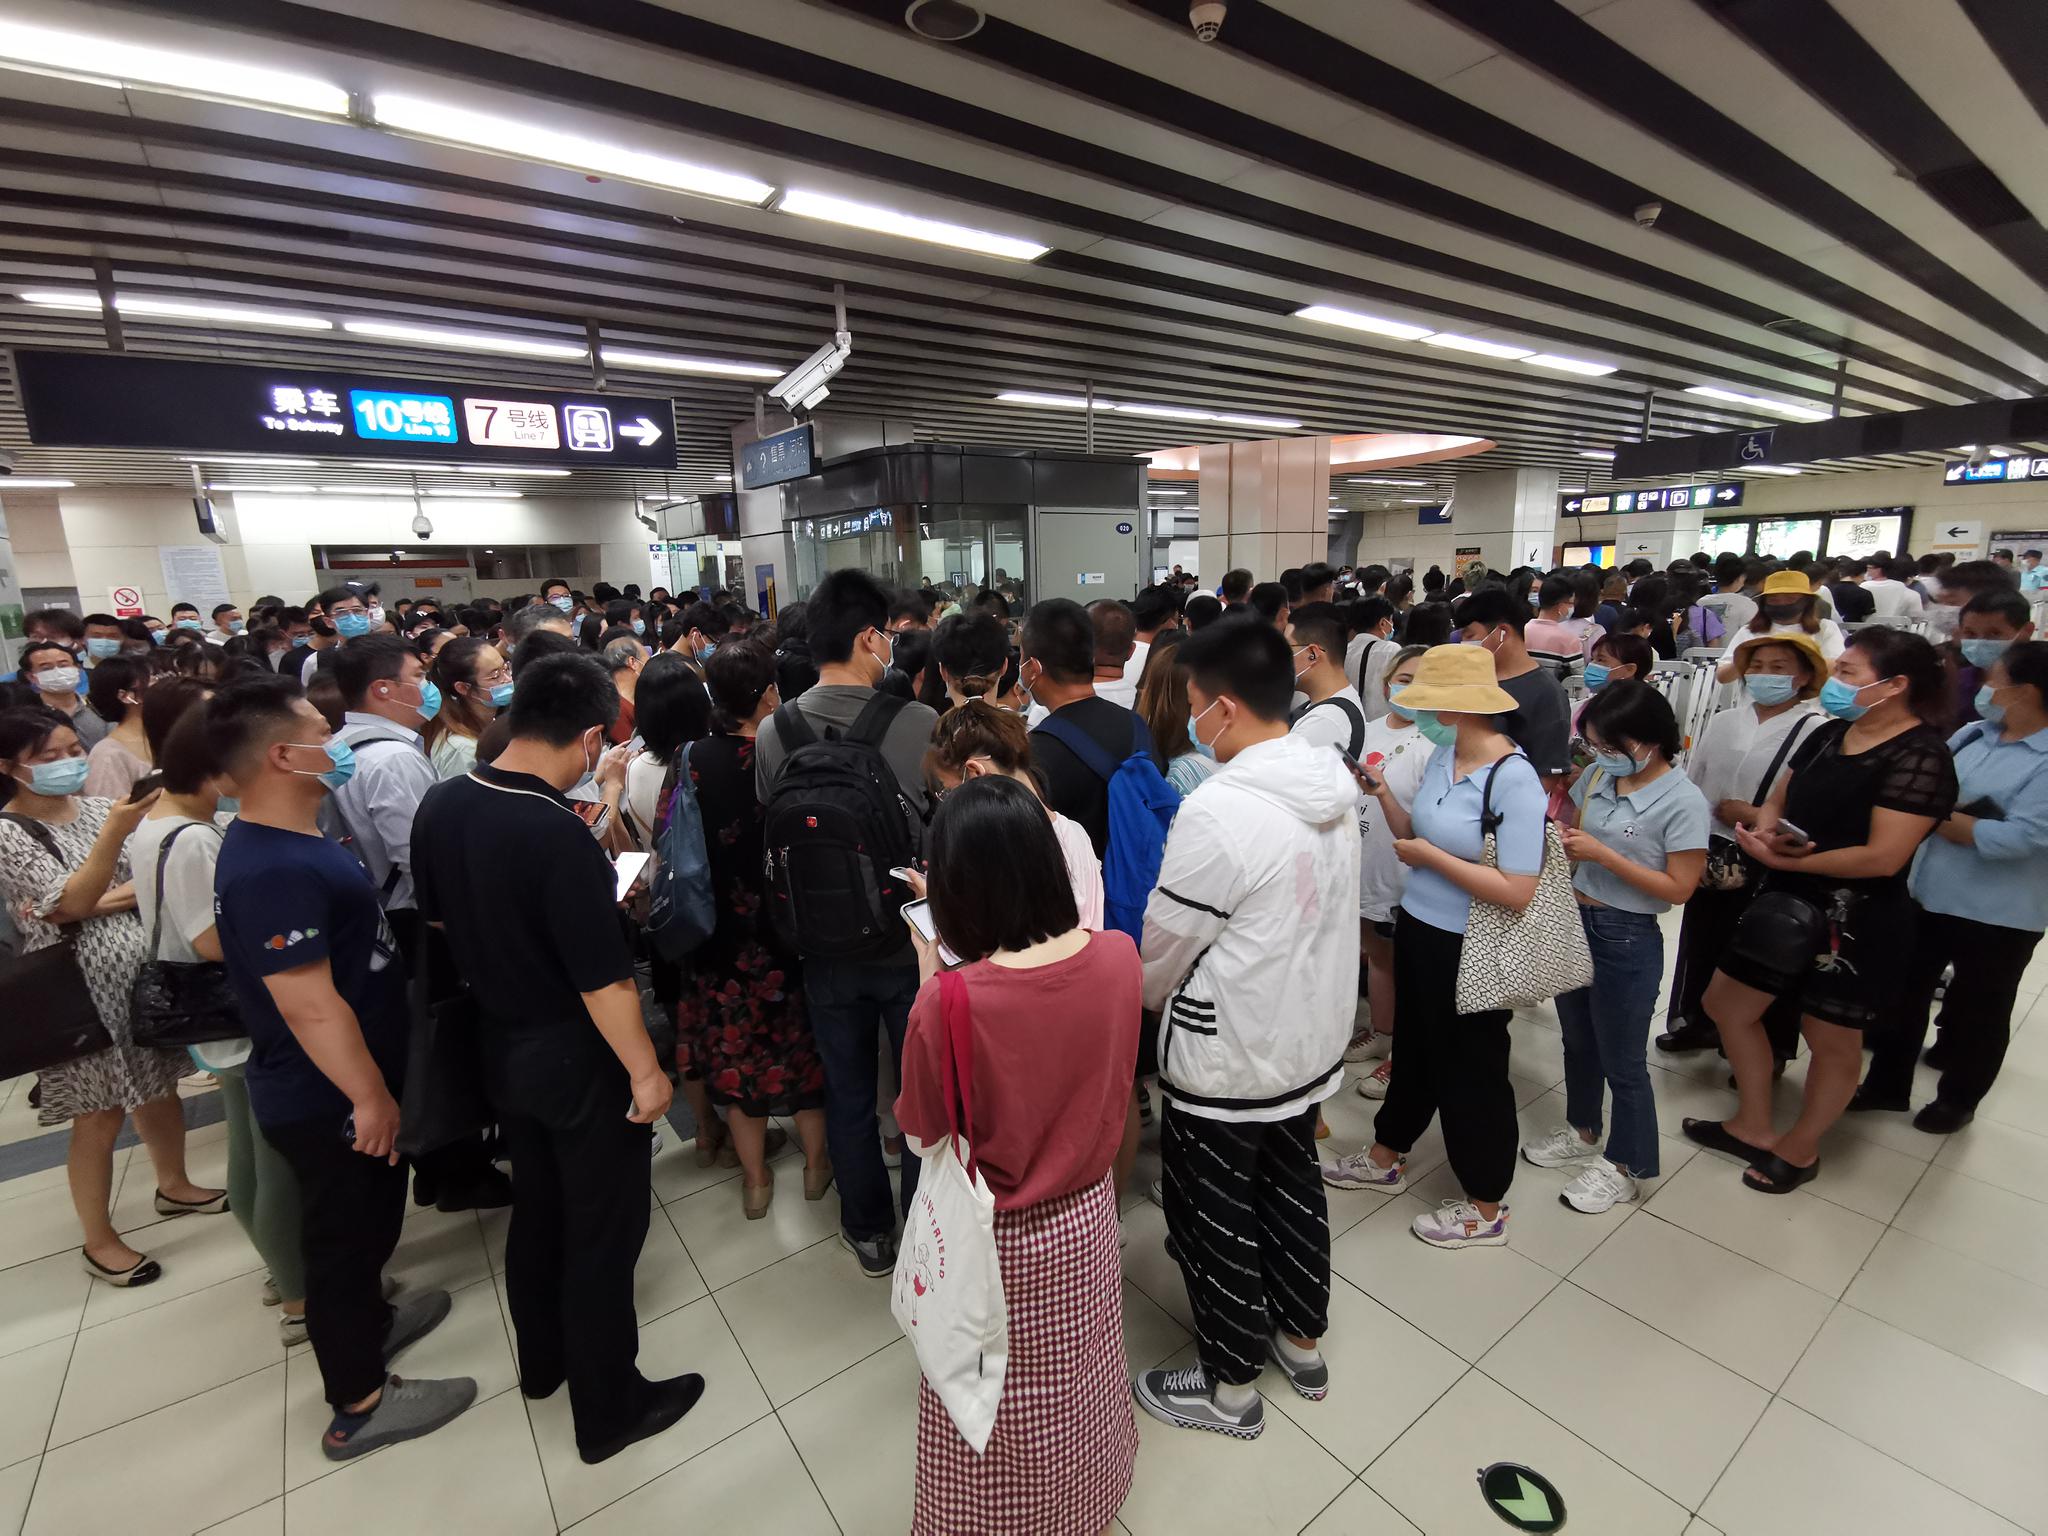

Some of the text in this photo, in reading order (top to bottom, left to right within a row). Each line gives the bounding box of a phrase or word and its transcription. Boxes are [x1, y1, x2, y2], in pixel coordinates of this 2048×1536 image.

[273, 386, 341, 417] 乘车
[514, 430, 546, 441] Line 7
[1673, 492, 1686, 505] D
[930, 1218, 945, 1279] FRIEND
